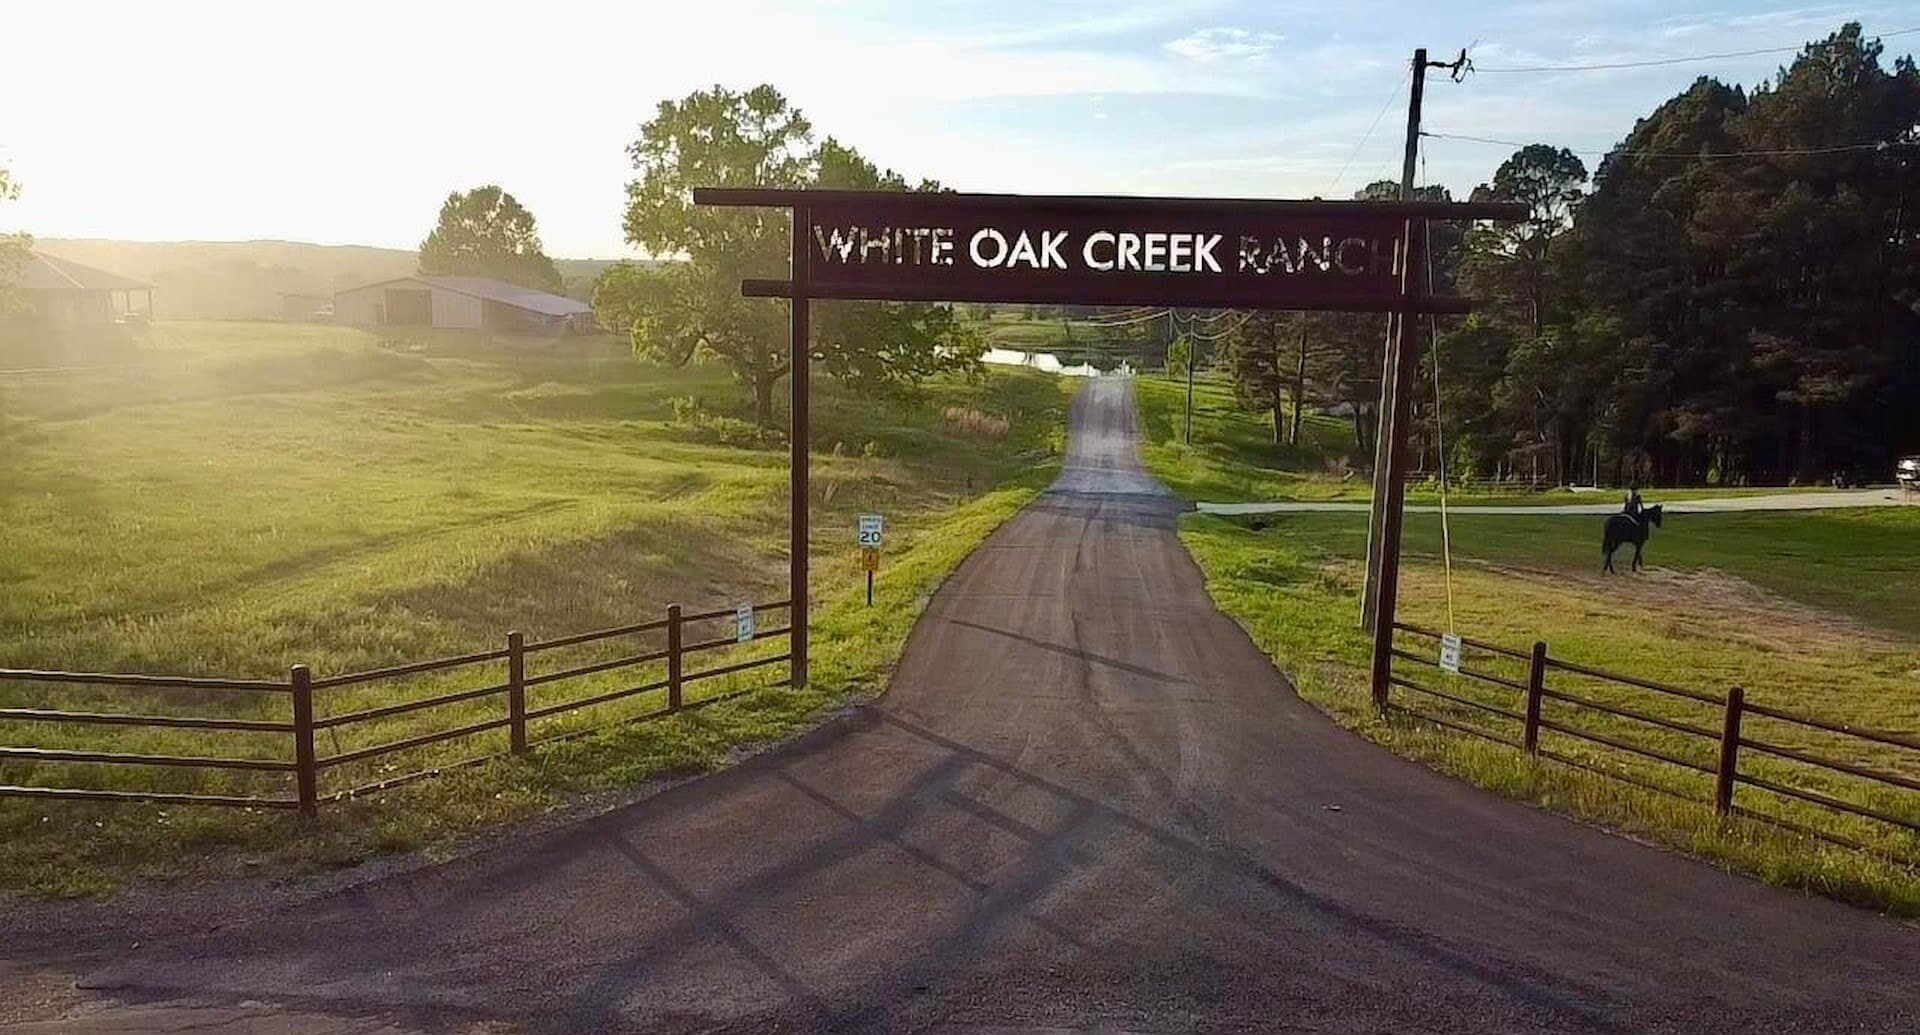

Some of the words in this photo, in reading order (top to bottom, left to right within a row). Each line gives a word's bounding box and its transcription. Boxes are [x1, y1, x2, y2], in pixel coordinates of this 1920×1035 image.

[813, 225, 954, 265] WHITE
[969, 228, 1069, 269] OAK
[1082, 230, 1224, 273] CREEK
[1238, 235, 1400, 275] RANCH
[860, 531, 881, 543] 20
